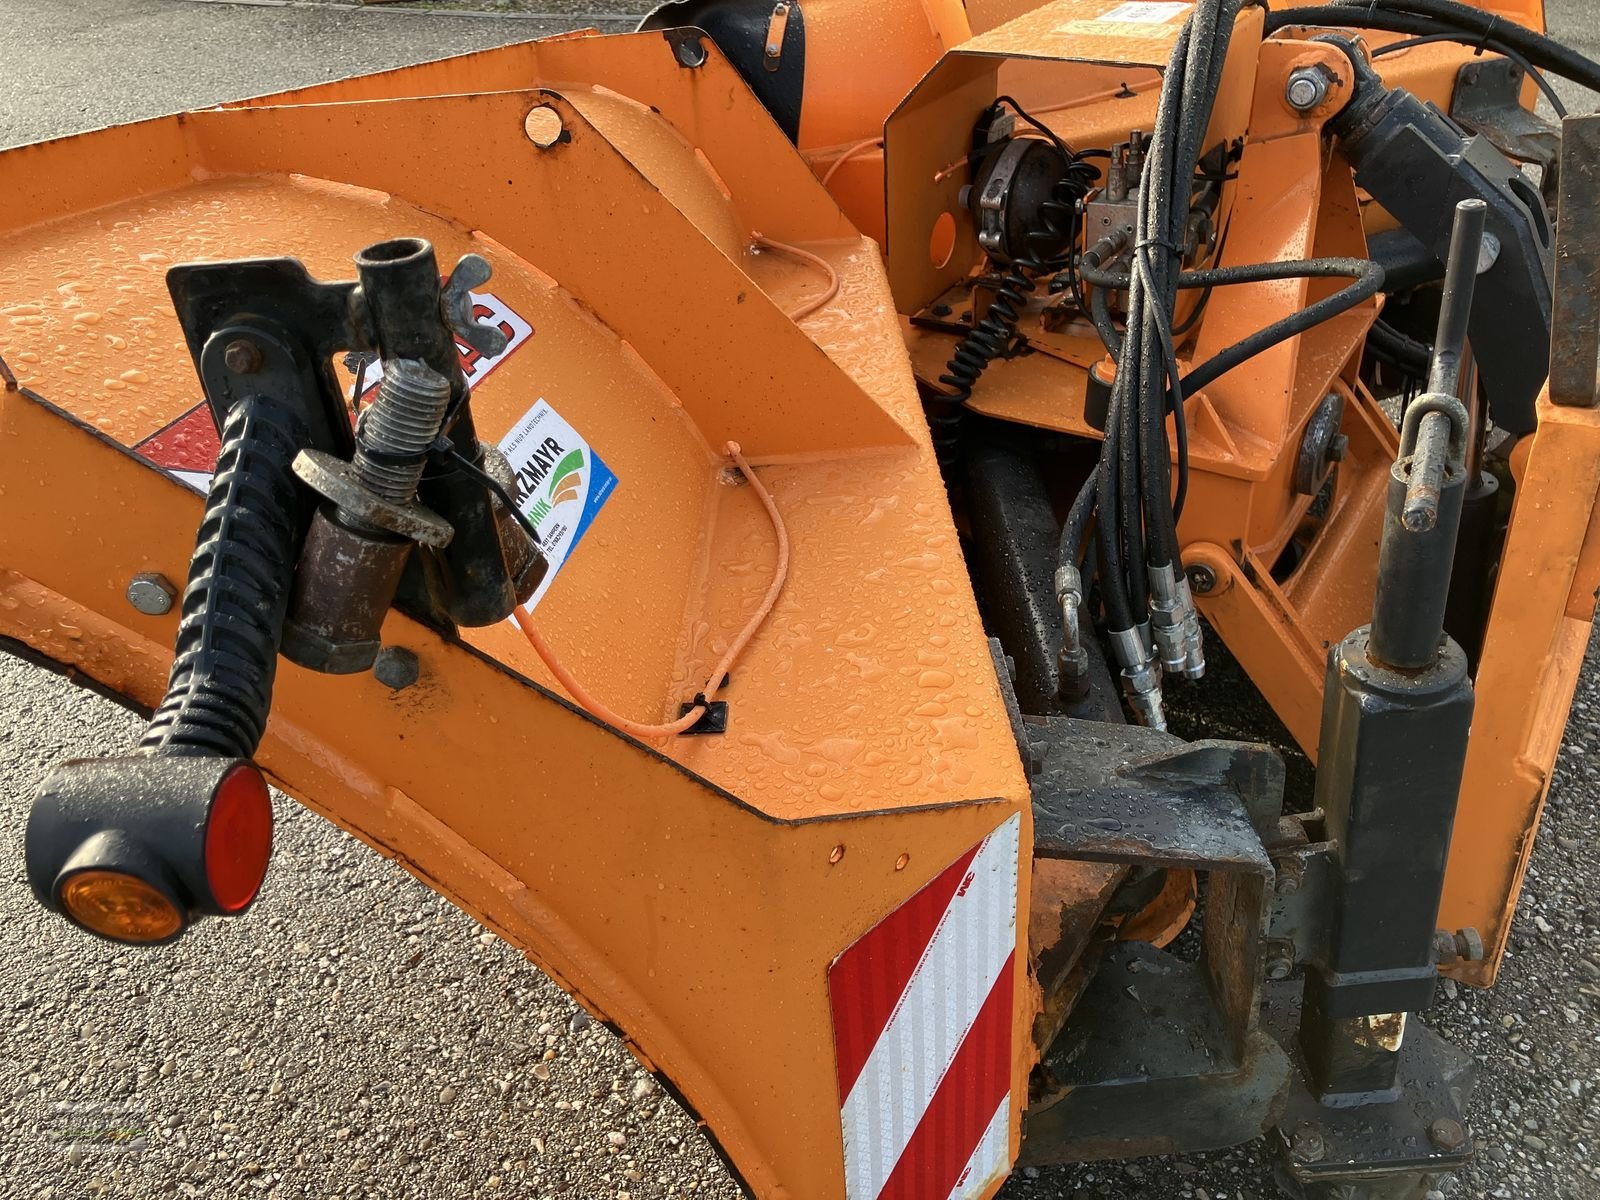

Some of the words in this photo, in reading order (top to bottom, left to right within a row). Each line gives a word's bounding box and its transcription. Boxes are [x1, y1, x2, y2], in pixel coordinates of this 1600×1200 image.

[515, 436, 566, 508] RZMAYR
[526, 497, 552, 529] HNIK
[956, 870, 976, 898] 3M
[956, 1166, 972, 1188] 3M
